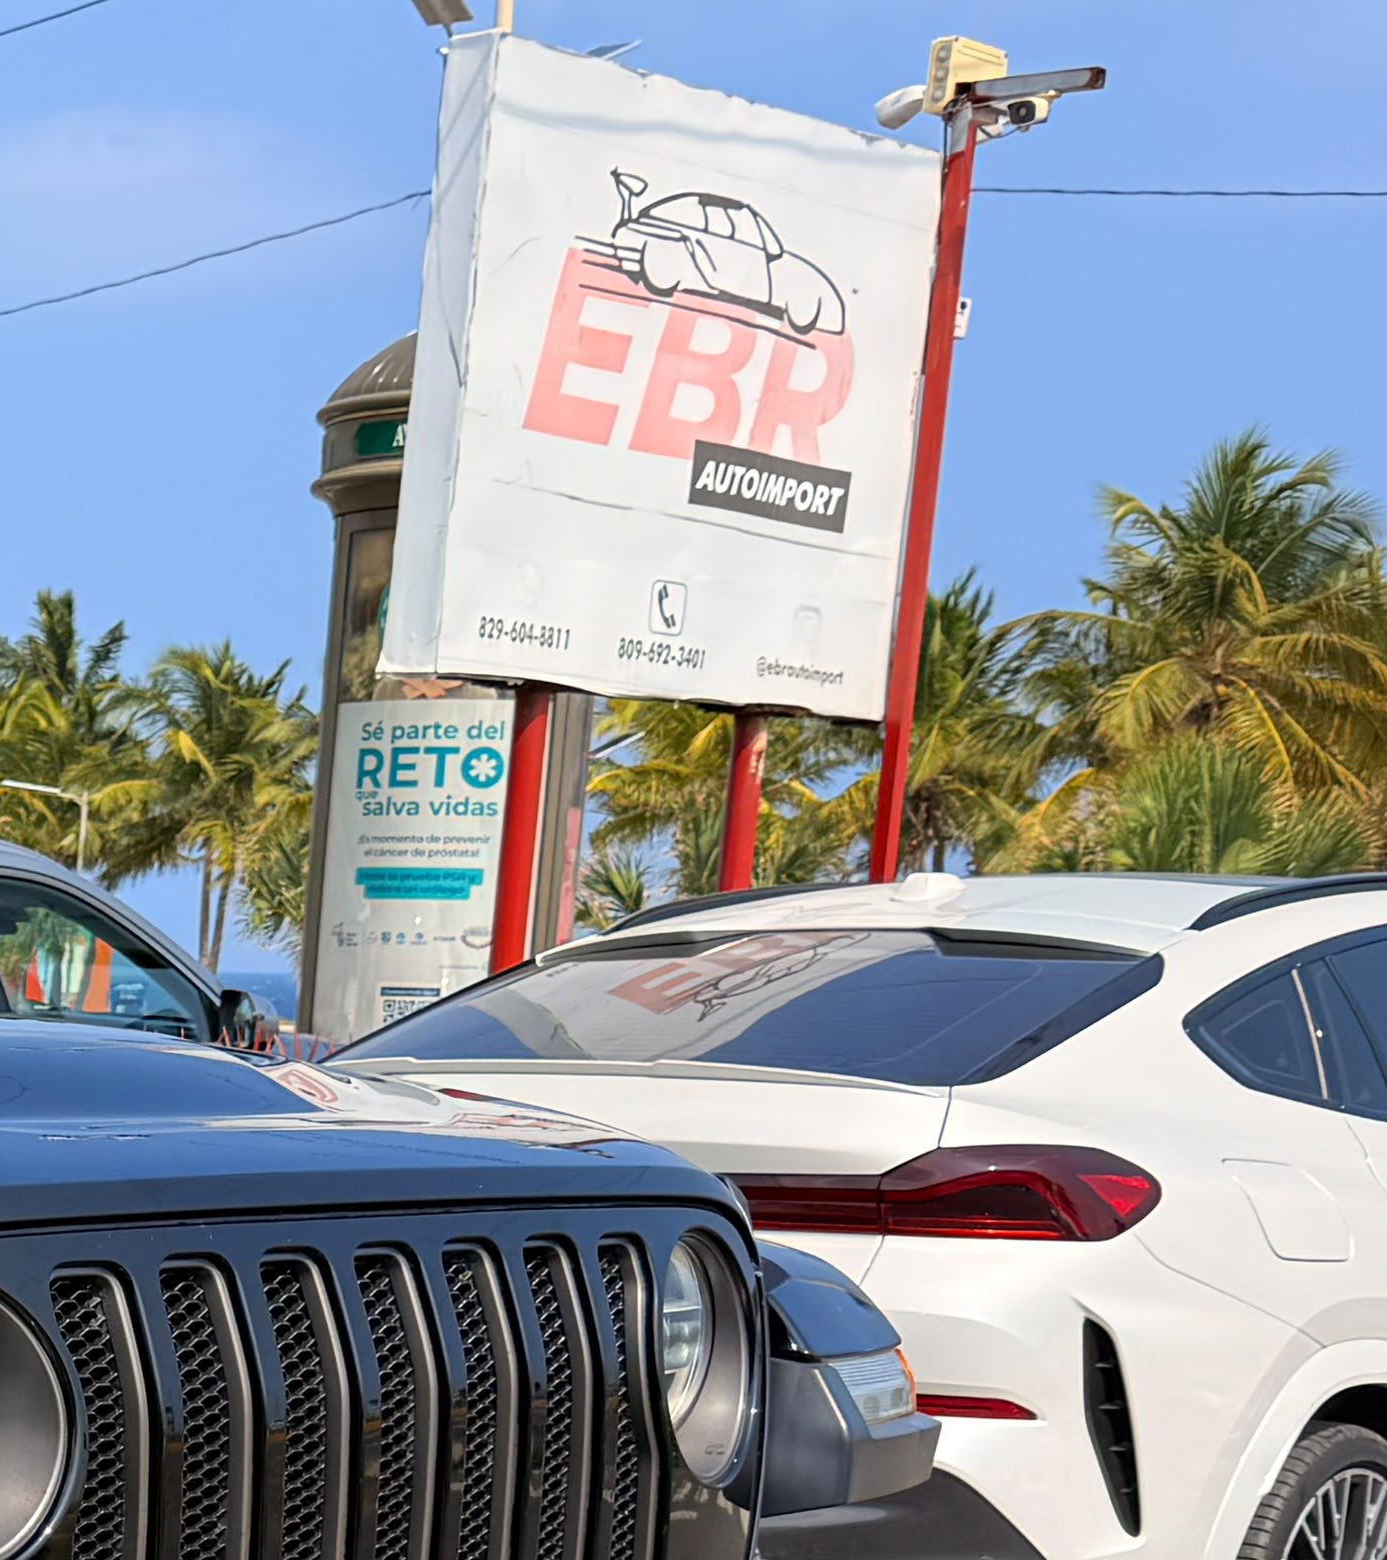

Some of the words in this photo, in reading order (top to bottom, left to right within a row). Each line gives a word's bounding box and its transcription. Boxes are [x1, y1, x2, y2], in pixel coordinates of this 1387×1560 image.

[522, 247, 855, 466] EBR
[695, 460, 845, 517] AUTOIMPORT
[361, 720, 384, 741] Sé
[391, 722, 459, 743] parte
[466, 720, 505, 740] del
[356, 746, 505, 790] RETO
[355, 790, 379, 802] que
[362, 796, 420, 817] salva
[429, 795, 499, 817] vidas
[371, 835, 424, 845] momento
[425, 833, 442, 845] de
